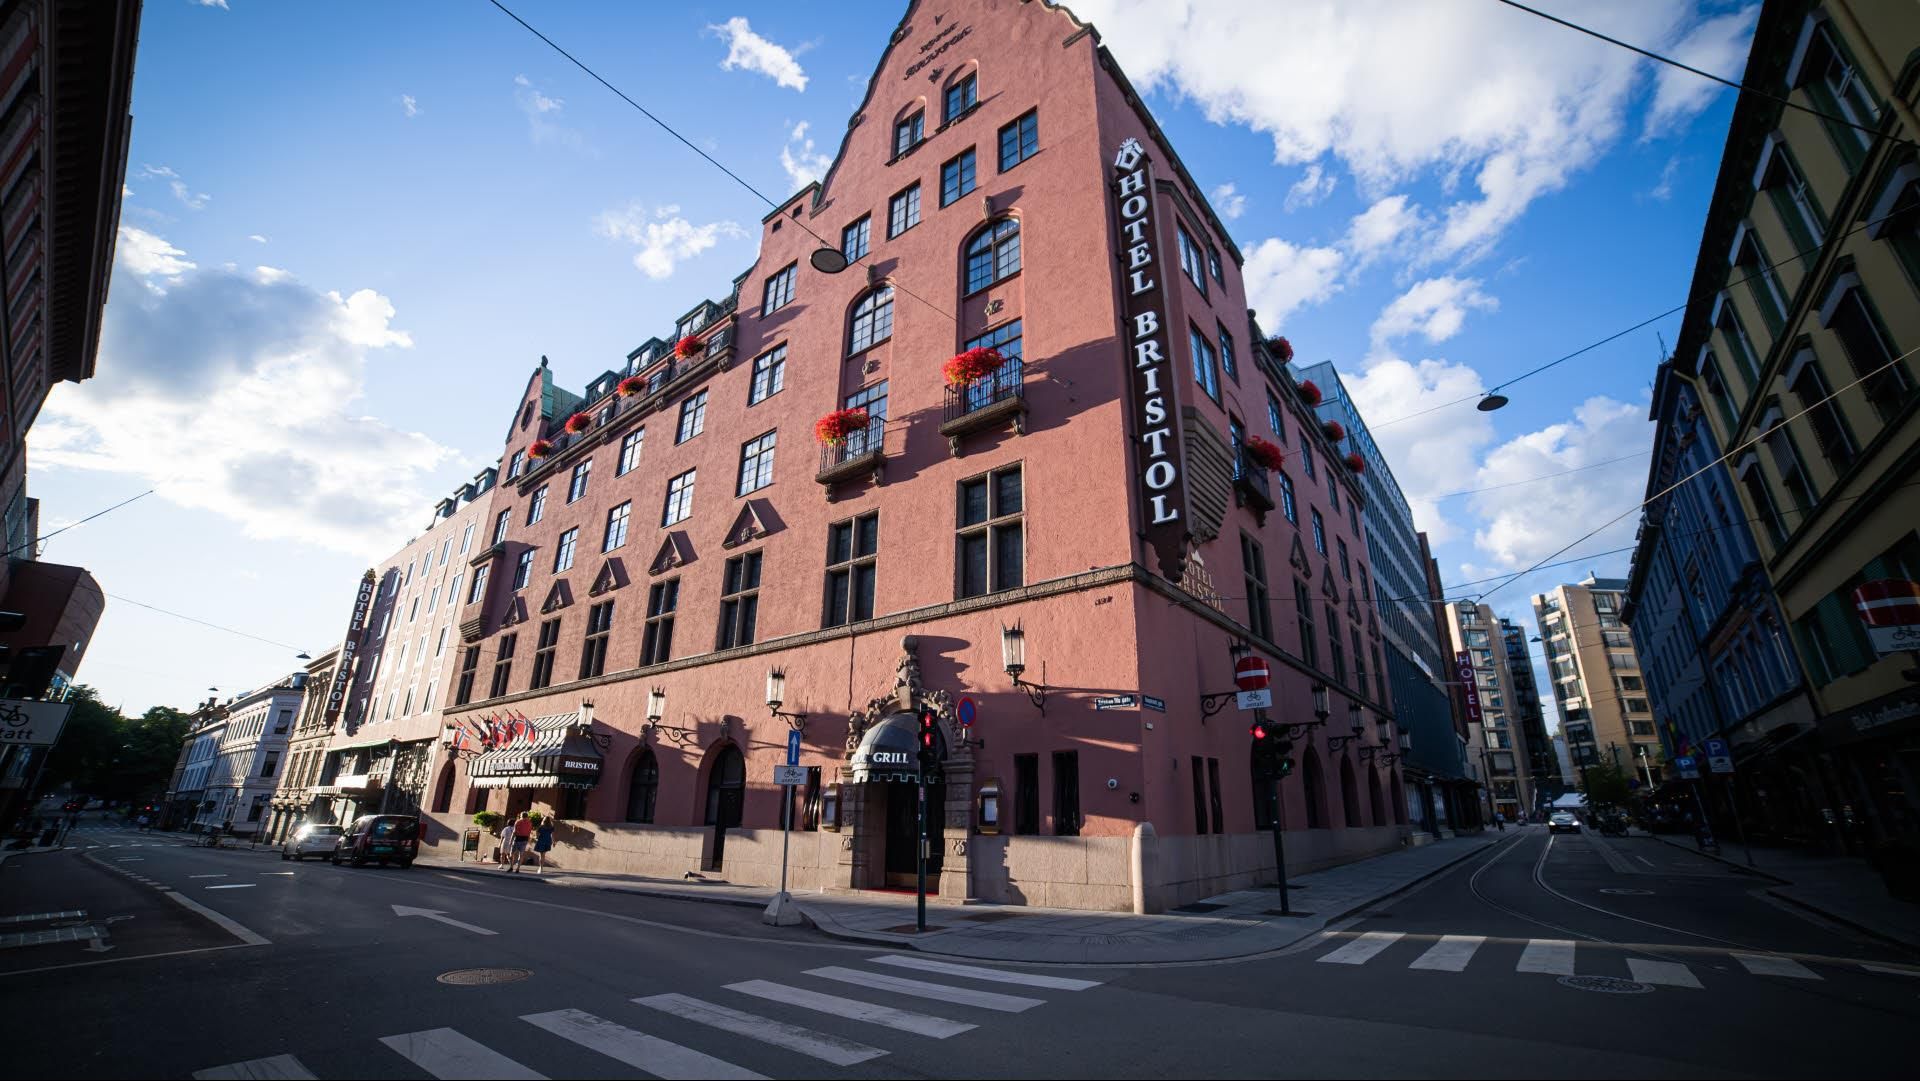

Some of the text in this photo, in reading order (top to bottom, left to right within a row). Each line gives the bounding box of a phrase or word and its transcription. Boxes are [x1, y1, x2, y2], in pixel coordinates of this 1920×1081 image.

[1117, 169, 1178, 525] HOTEL BRISTOL
[329, 583, 372, 711] HOTEL BRISTOL
[1459, 656, 1478, 718] HOTEL
[564, 761, 599, 770] BRISTOL
[872, 752, 909, 764] GRILL
